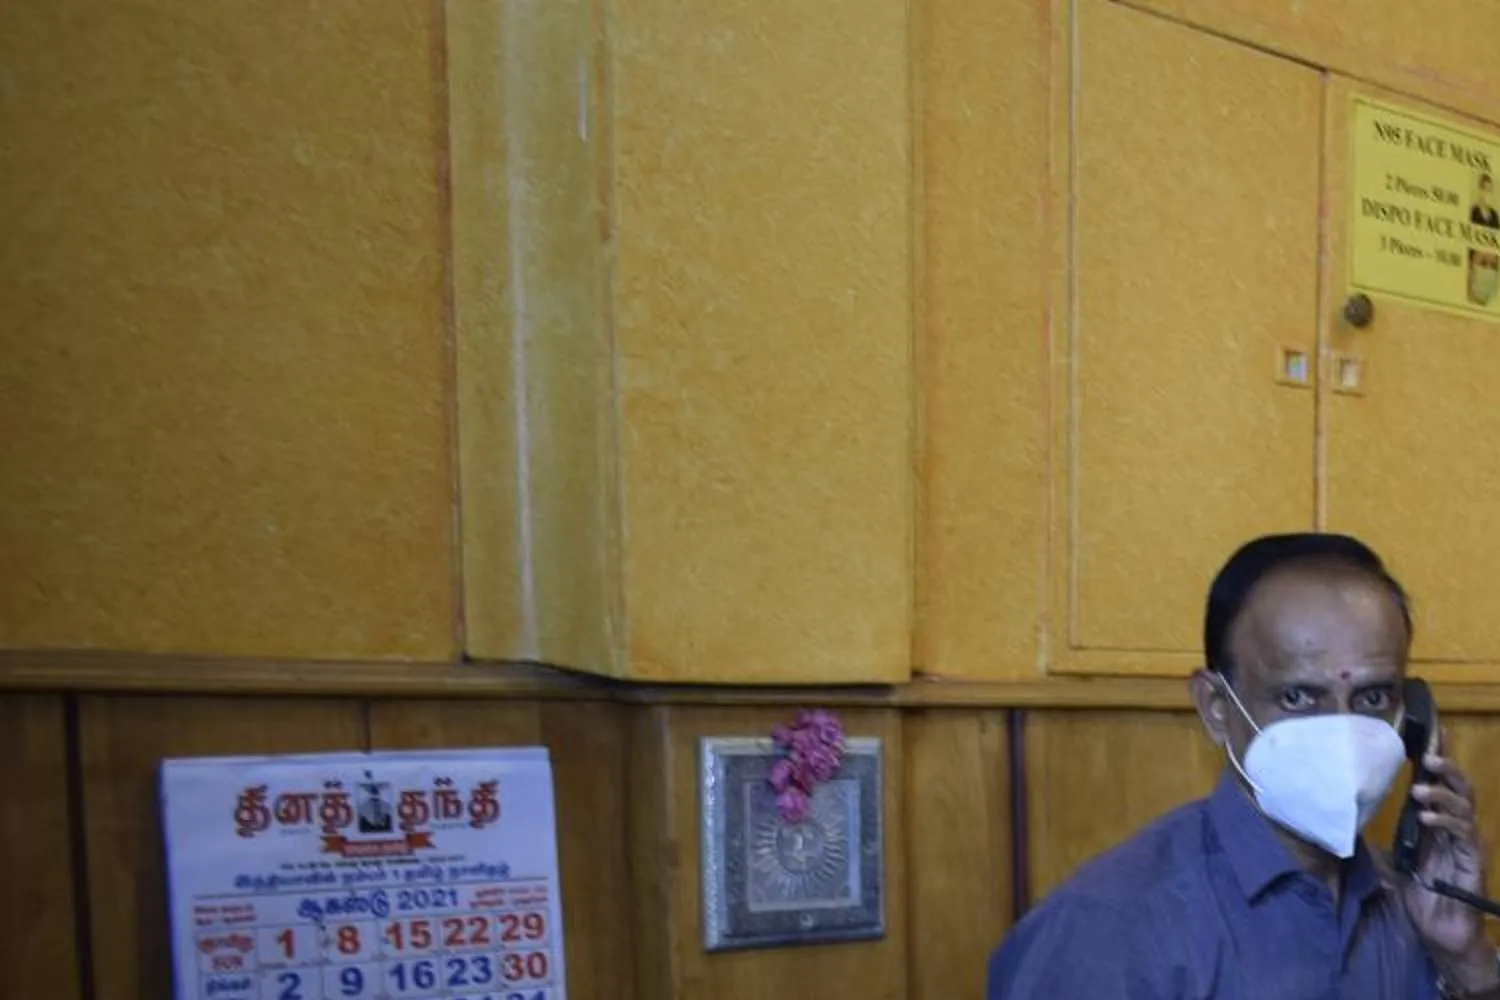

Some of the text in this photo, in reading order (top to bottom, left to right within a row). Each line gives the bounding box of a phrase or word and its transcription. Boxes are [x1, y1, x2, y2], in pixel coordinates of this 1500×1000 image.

[1404, 128, 1446, 158] FACE
[1450, 142, 1492, 173] MASK
[1414, 209, 1454, 238] FACE
[1458, 220, 1500, 250] MASK
[397, 888, 458, 911] 2021
[277, 913, 545, 959] 1 8 15 22 29
[341, 967, 363, 995] 9
[388, 961, 434, 992] 16
[446, 956, 492, 986] 23
[502, 951, 547, 981] 30
